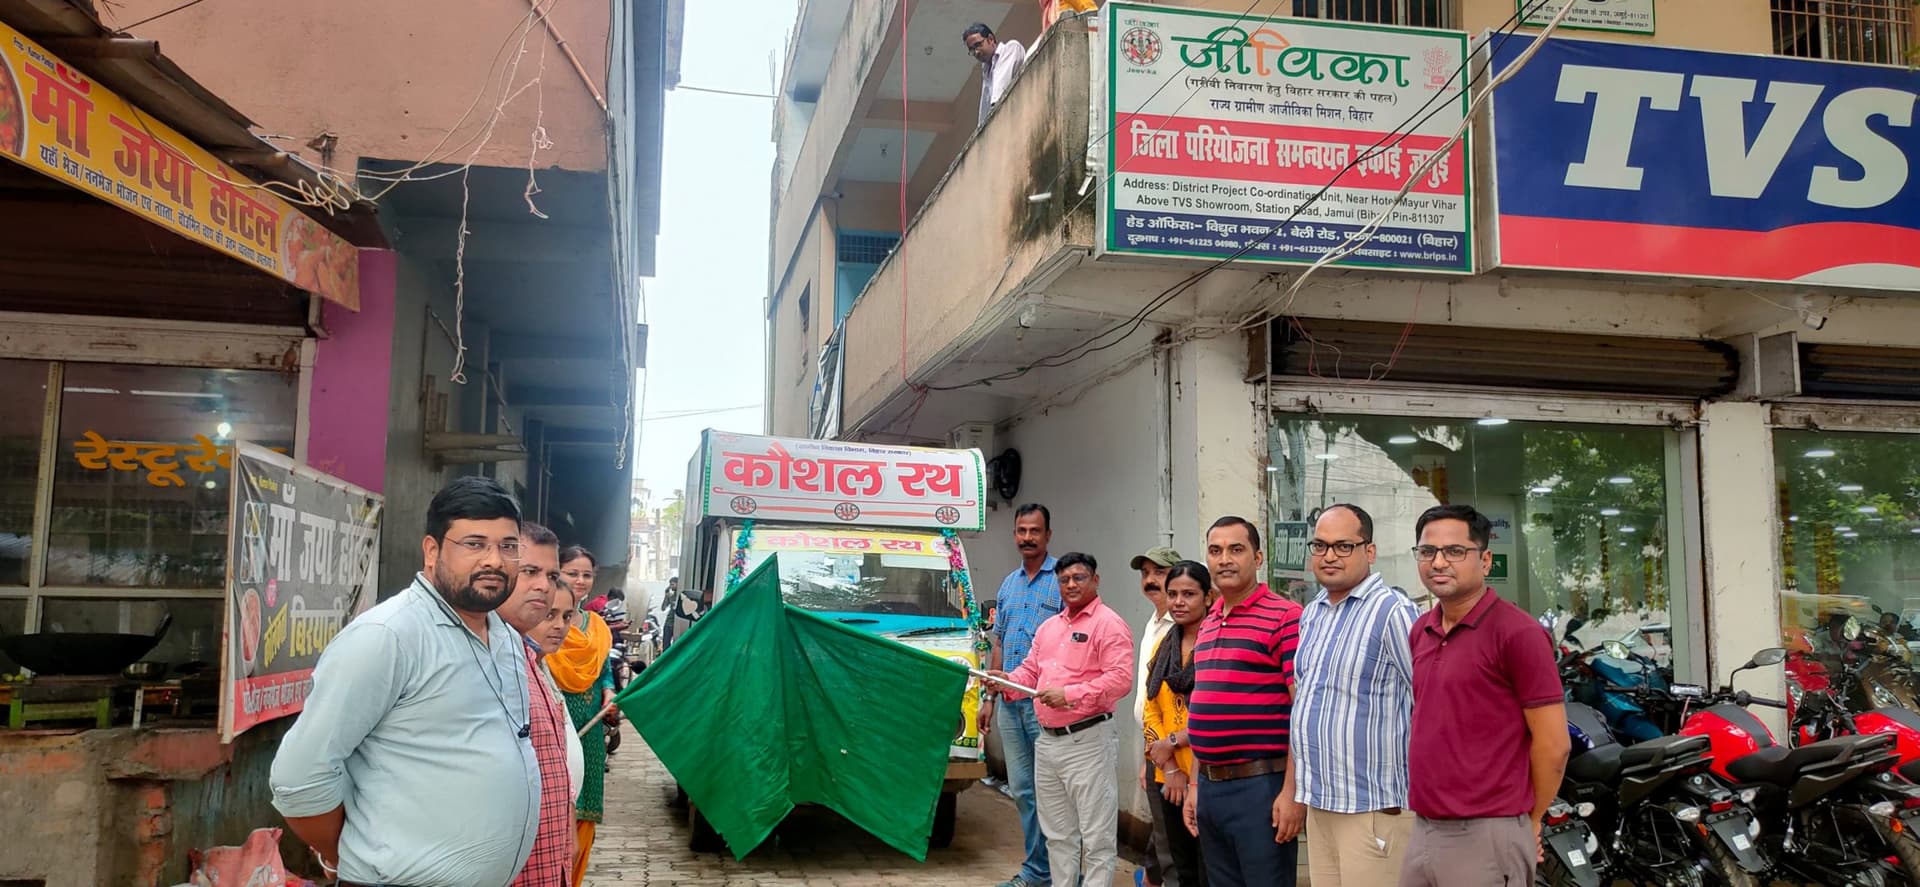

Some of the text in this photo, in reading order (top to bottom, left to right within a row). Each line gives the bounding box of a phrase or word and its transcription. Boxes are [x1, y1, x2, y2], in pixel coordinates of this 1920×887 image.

[1171, 26, 1410, 88] जीविका
[1210, 99, 1230, 111] राज्य
[1235, 98, 1265, 114] ग्रामीण
[1316, 104, 1345, 121] मिशन,
[1225, 79, 1263, 92] निवारण
[1266, 83, 1281, 97] हेतु
[1317, 89, 1350, 100] सरकार
[1354, 90, 1366, 101] की
[1370, 92, 1398, 105] पहल)
[1130, 119, 1180, 160] जिला
[1184, 124, 1271, 166] परियोजना
[1274, 138, 1349, 172] समन्वयन
[1355, 139, 1403, 179] इकाई
[1554, 63, 1917, 209] TVS
[109, 113, 198, 210] जया
[208, 163, 279, 253] होटल
[1123, 178, 1170, 191] Address:
[1172, 181, 1209, 194] District
[1211, 184, 1248, 197] Project
[1320, 191, 1342, 203] Unit,
[1346, 194, 1368, 204] Near
[1400, 198, 1430, 211] Mayur
[1432, 200, 1457, 210] Vihar
[1126, 214, 1145, 228] हेड
[1206, 219, 1237, 237] विद्युत
[1317, 228, 1340, 242] रोड,
[1137, 194, 1170, 206] Above
[1172, 197, 1193, 208] TVS
[1195, 199, 1252, 213] Showroom,
[1255, 202, 1291, 215] Station
[1325, 208, 1354, 219] Jamui
[1392, 213, 1445, 225] Pin-811307
[722, 440, 964, 498] कौशल रथ
[300, 511, 337, 585] जया
[766, 531, 924, 552] कौशल रथ
